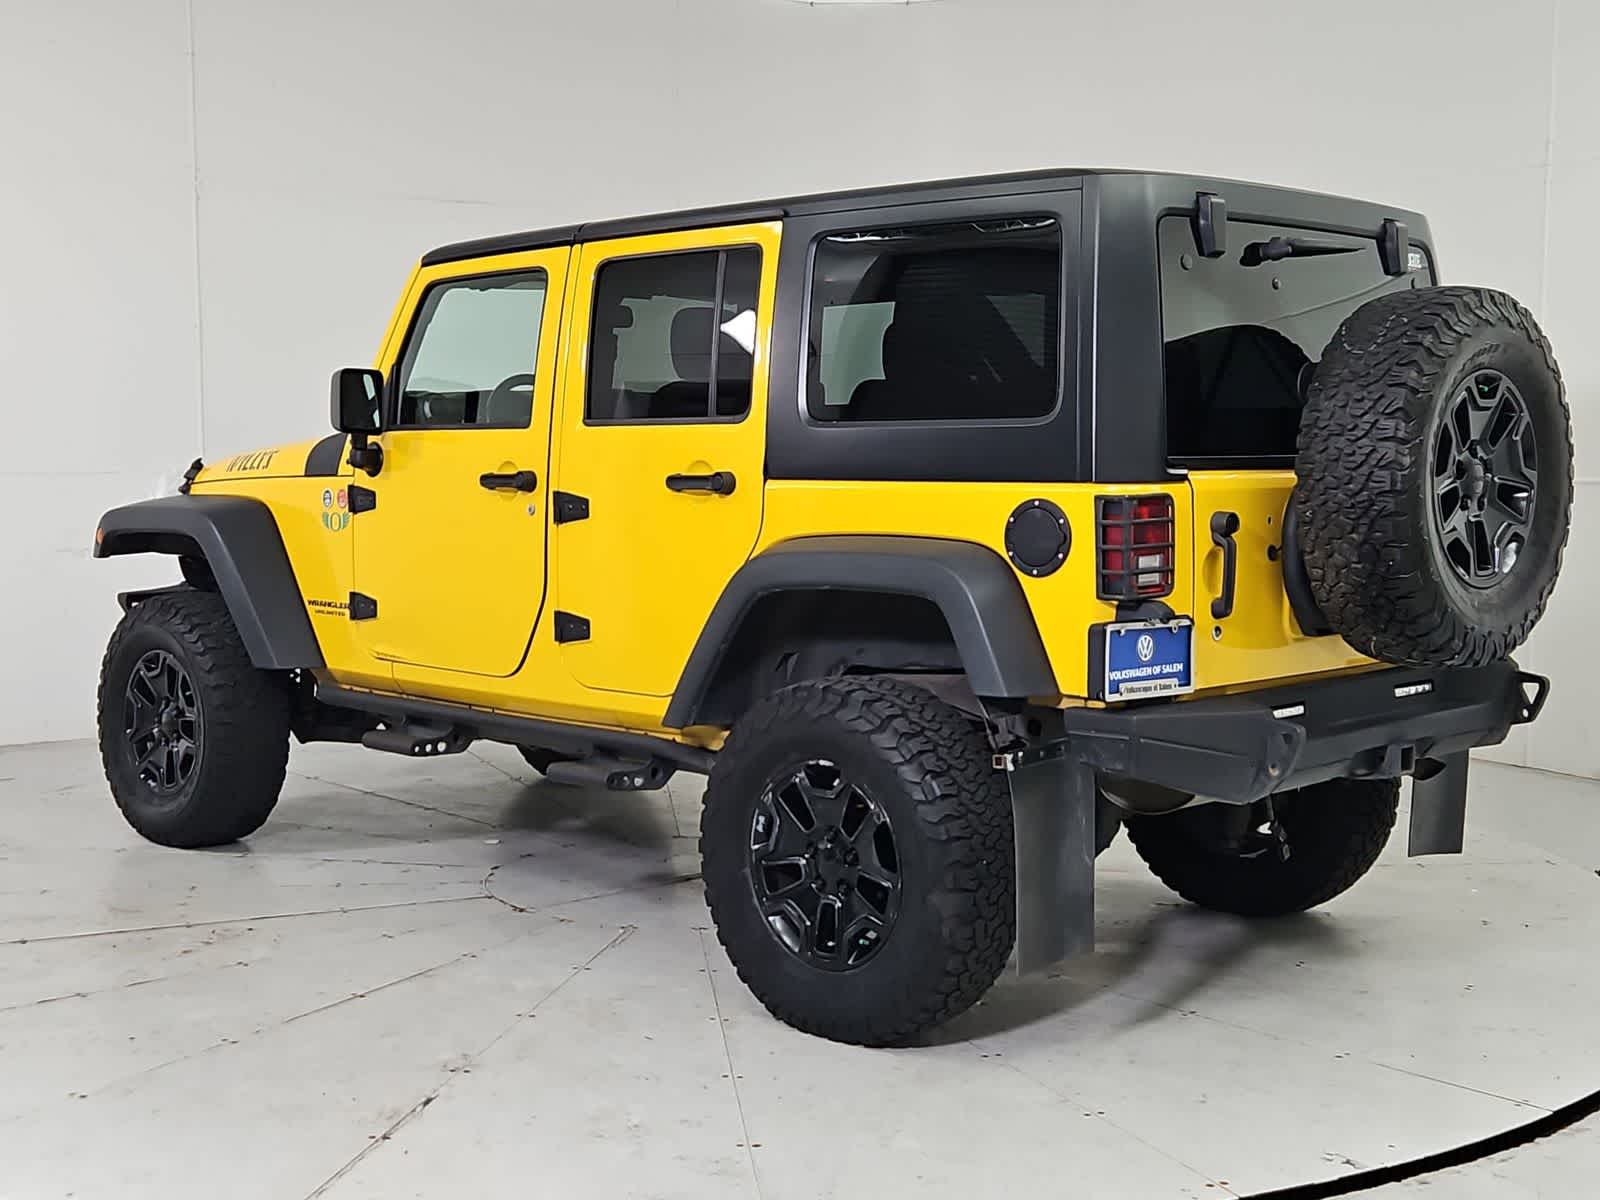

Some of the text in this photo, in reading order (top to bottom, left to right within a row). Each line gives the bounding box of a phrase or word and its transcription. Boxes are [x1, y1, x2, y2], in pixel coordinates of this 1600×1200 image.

[1109, 663, 1183, 680] VOLKSWAGEN OF SALEM
